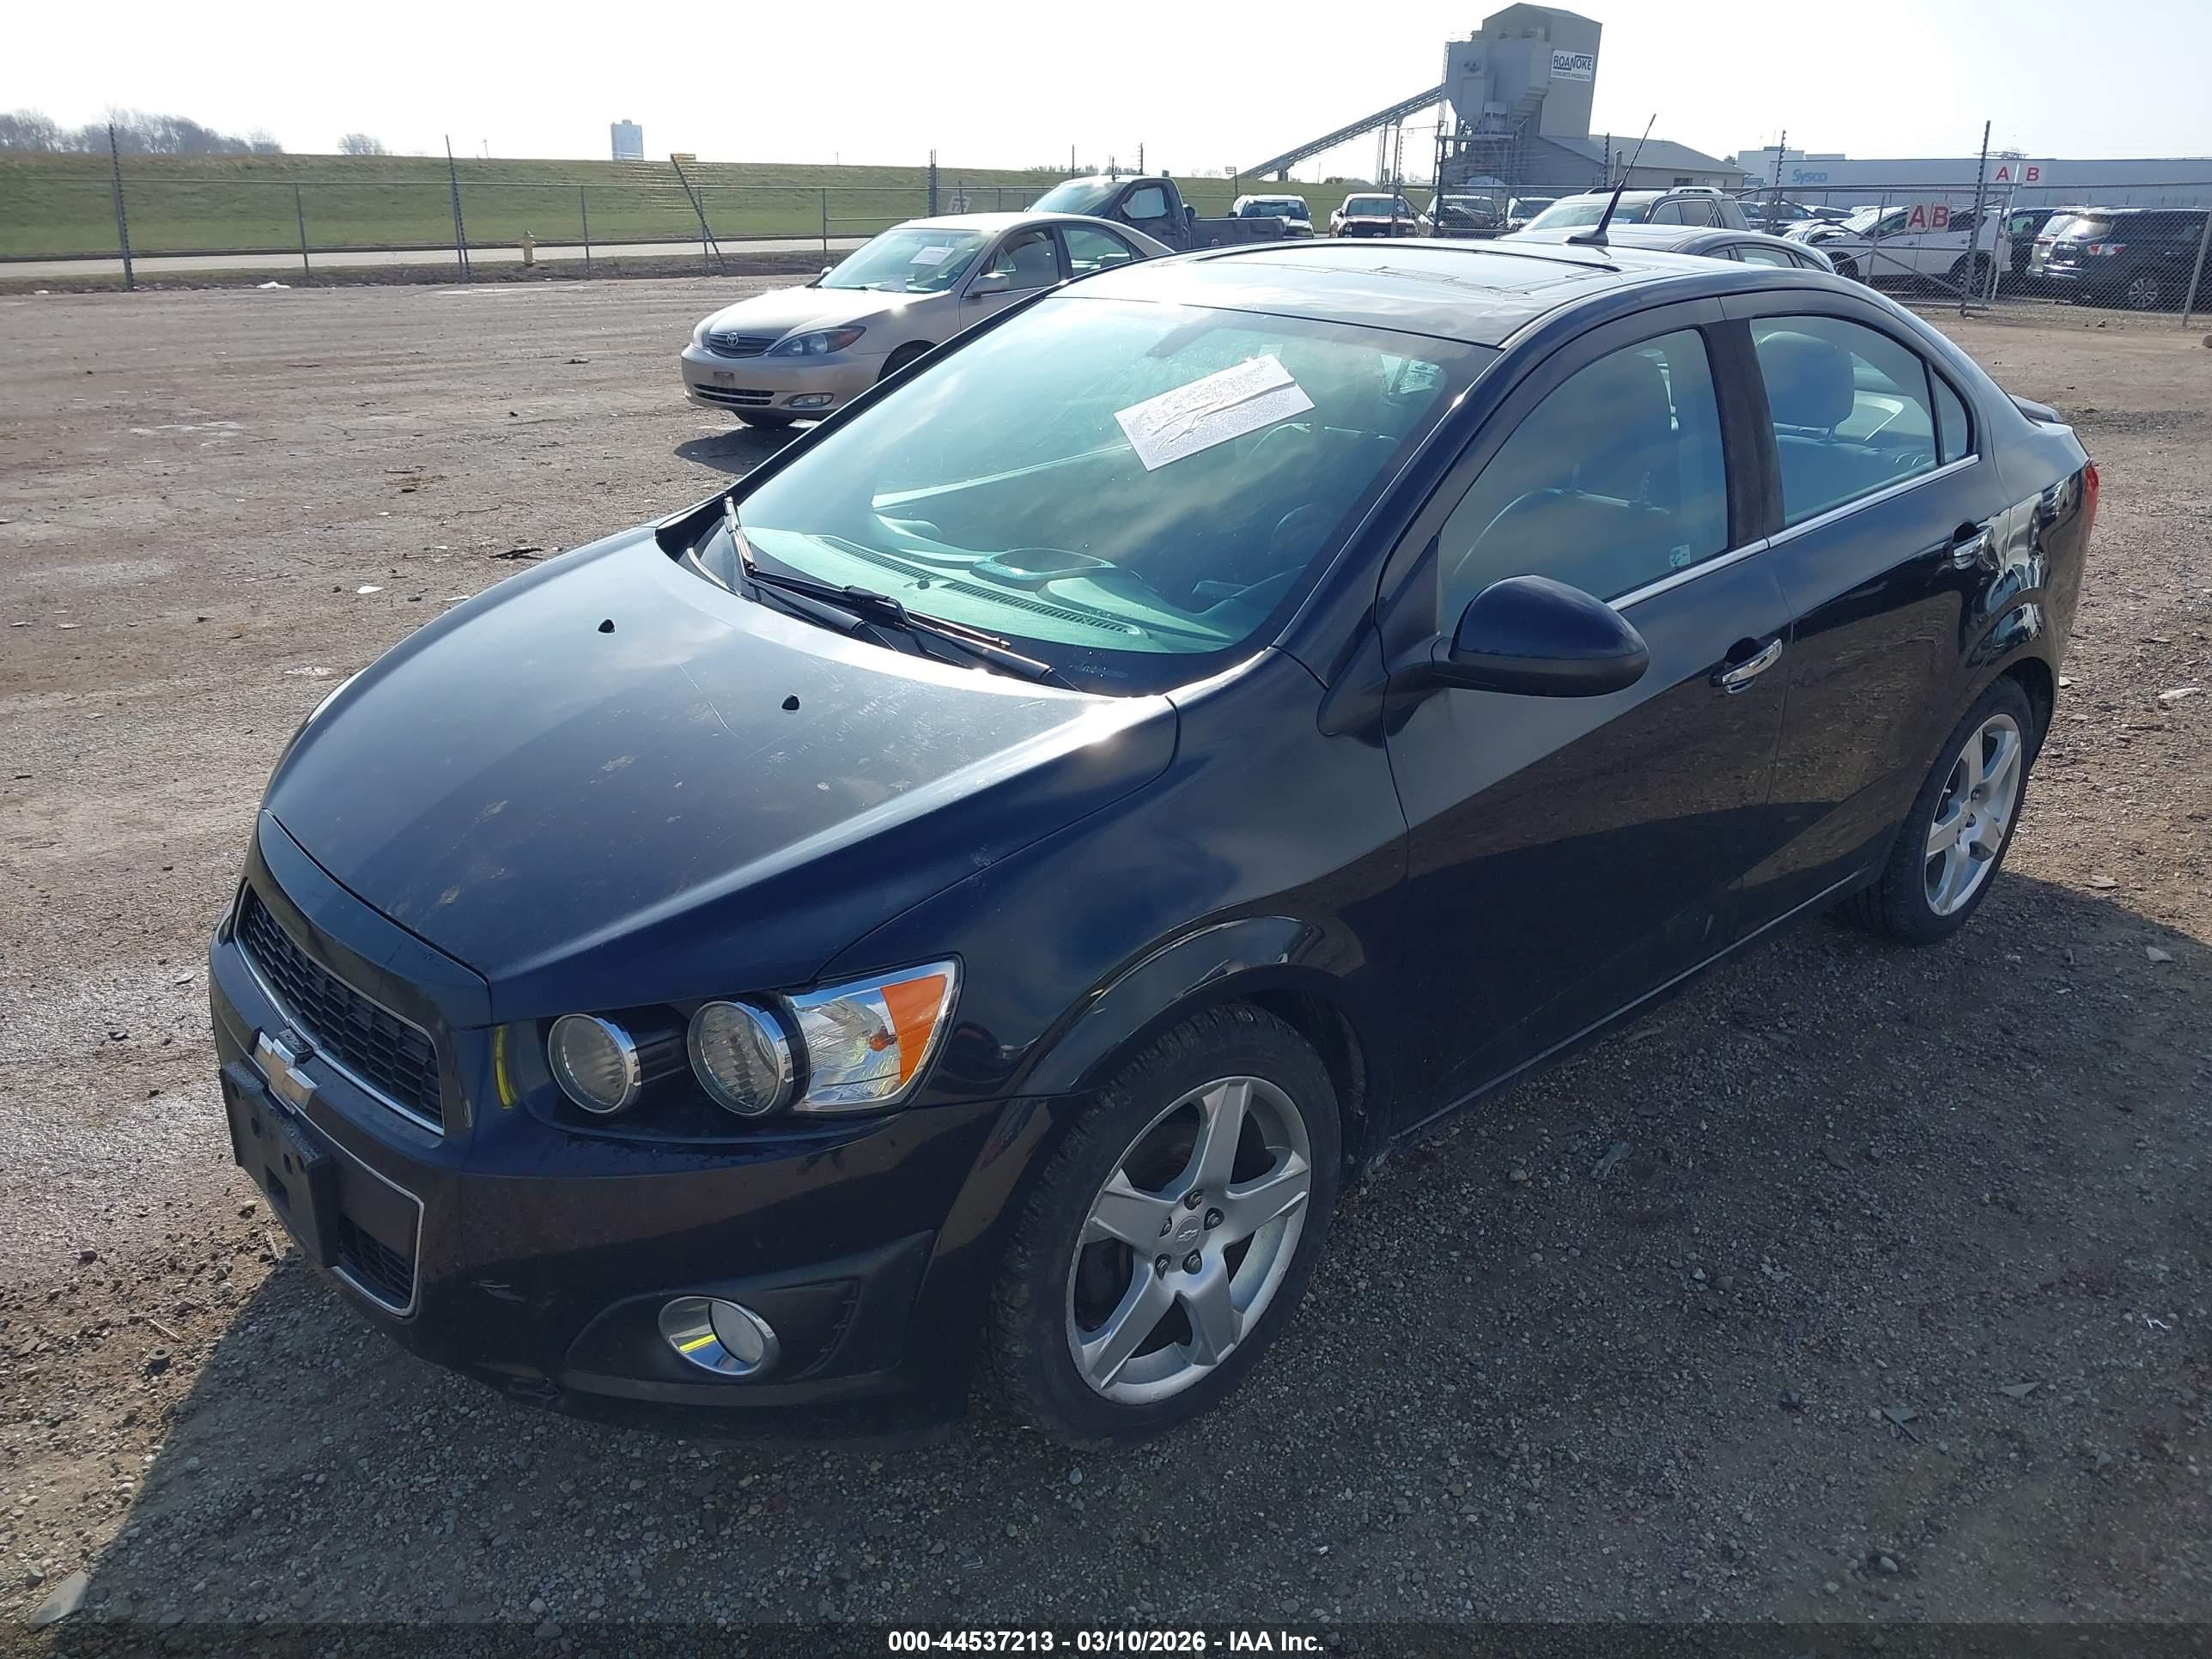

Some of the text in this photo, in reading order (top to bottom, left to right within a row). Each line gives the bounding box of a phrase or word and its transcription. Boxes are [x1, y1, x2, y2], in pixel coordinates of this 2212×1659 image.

[1553, 55, 1592, 70] ROANOKE
[1995, 166, 2040, 181] A B
